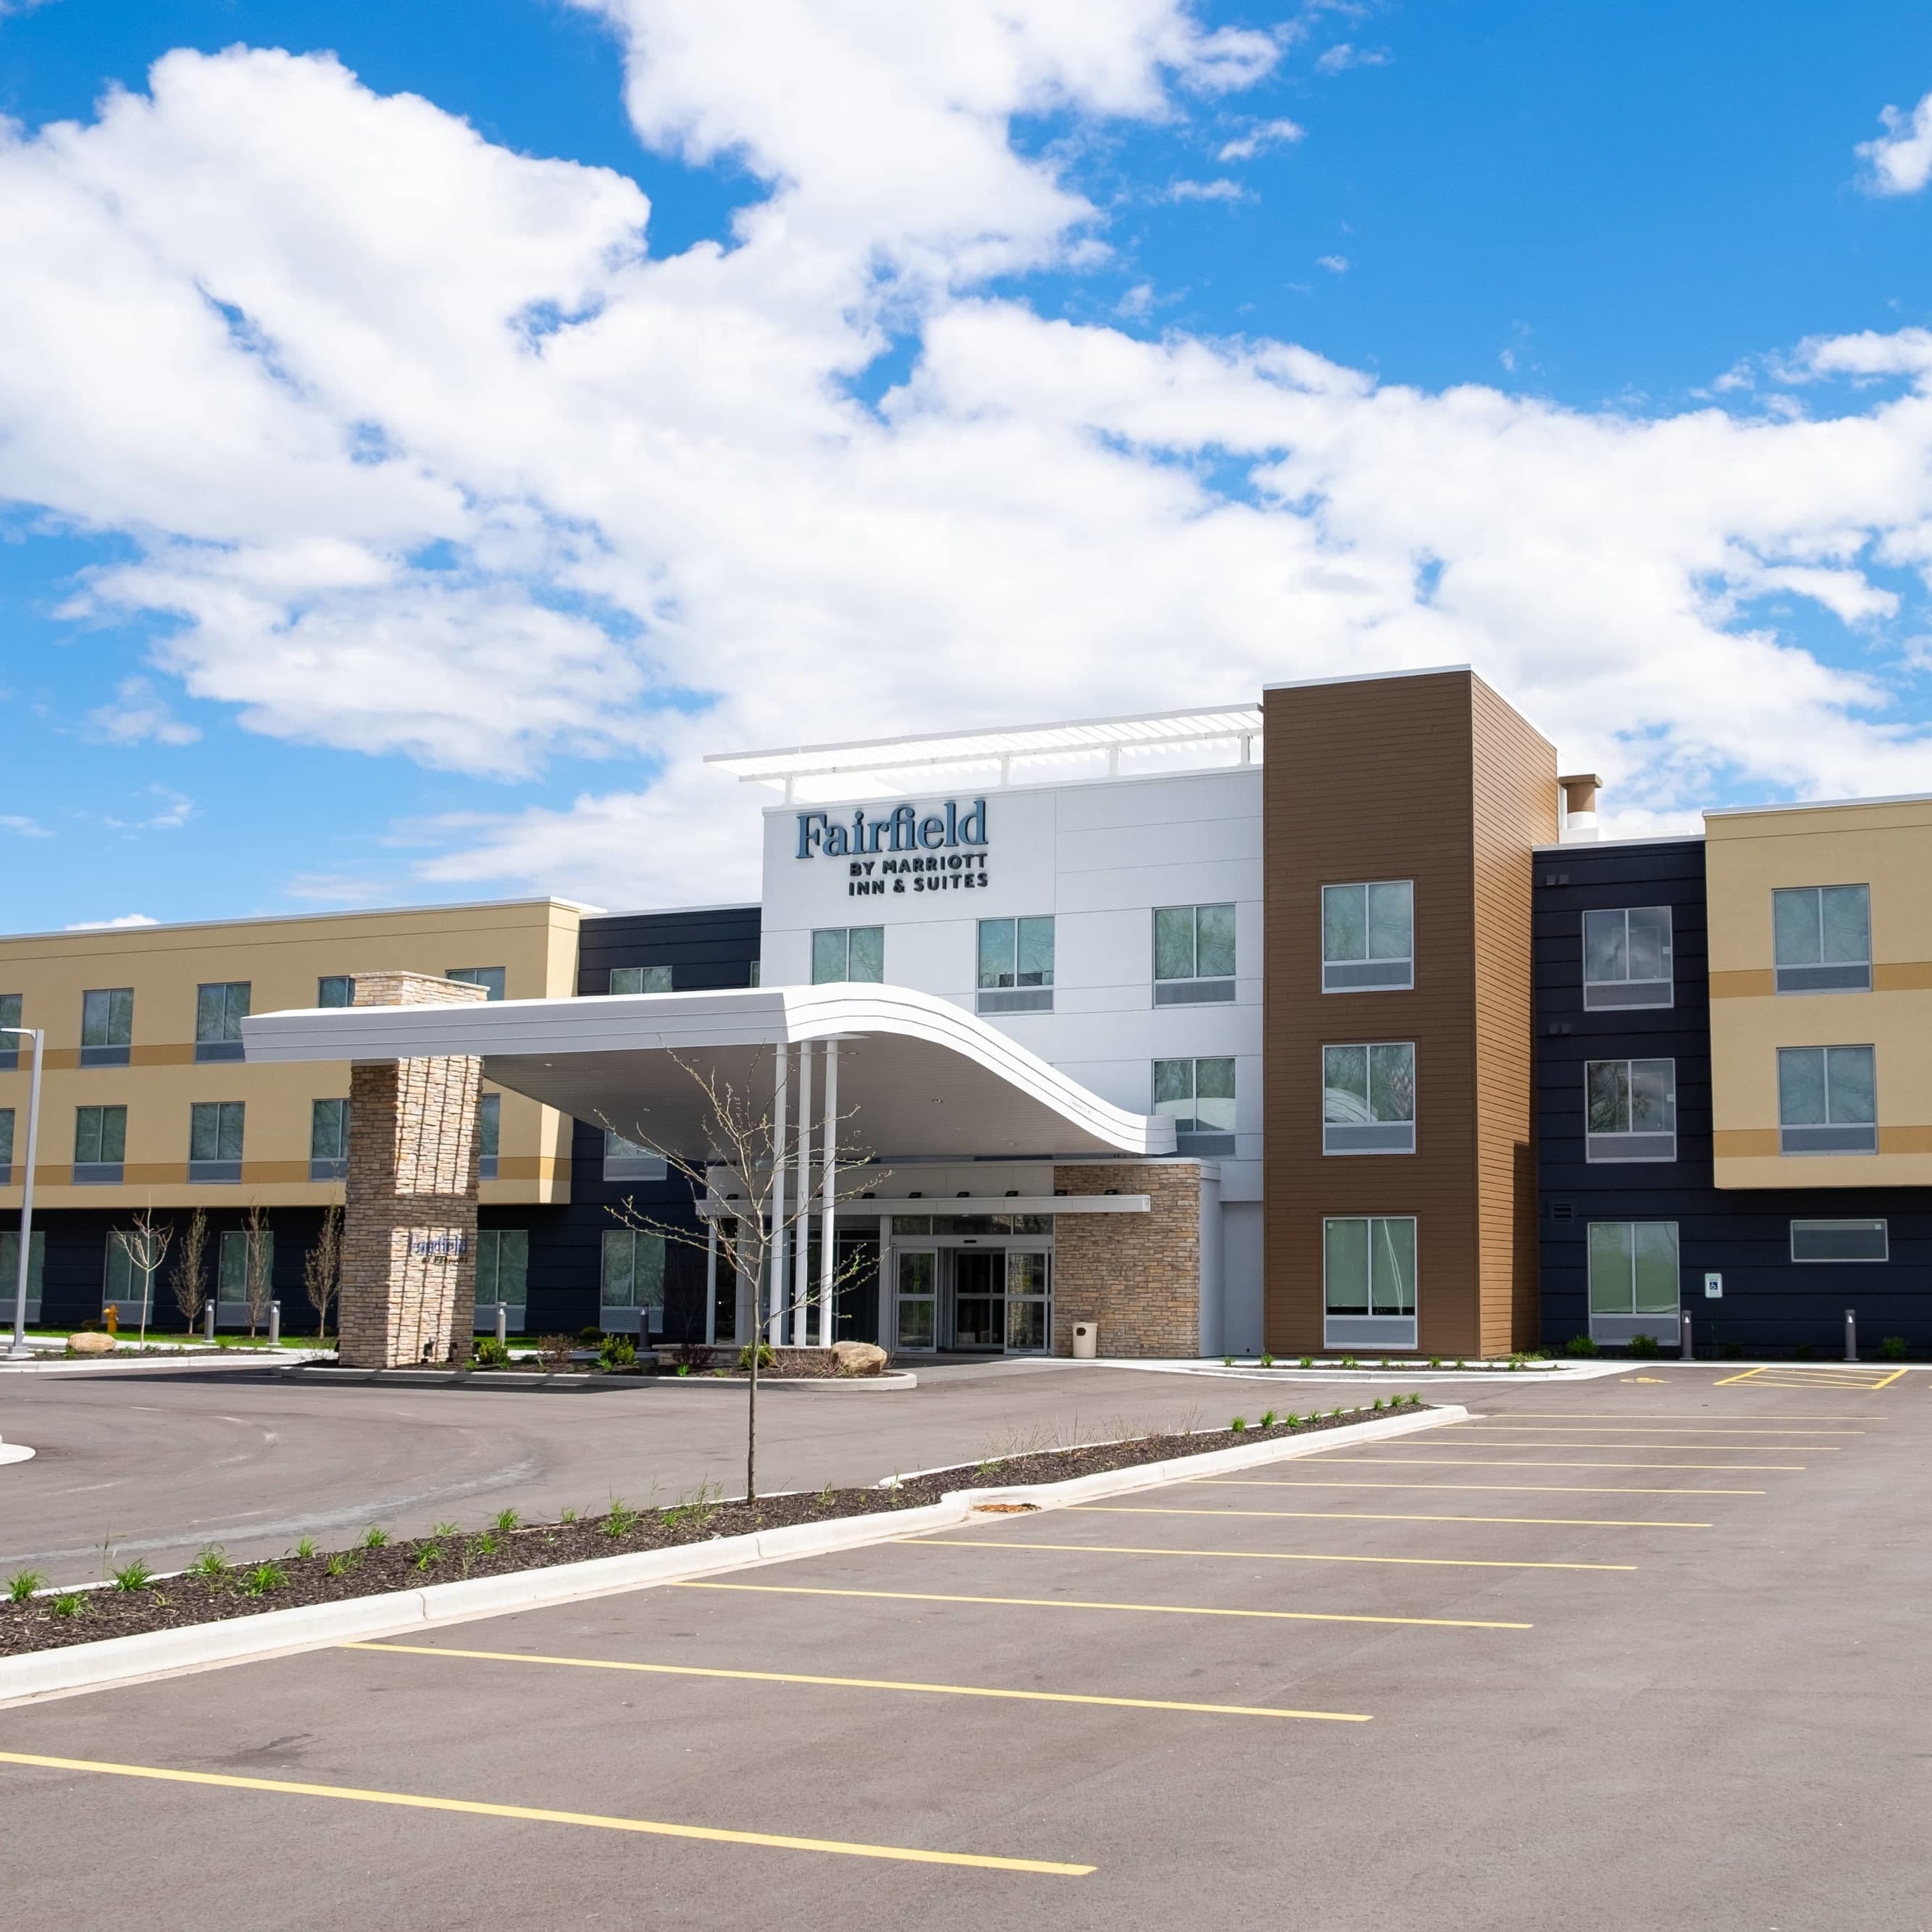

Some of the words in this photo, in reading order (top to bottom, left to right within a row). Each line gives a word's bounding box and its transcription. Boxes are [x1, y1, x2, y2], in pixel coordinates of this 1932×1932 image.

[795, 798, 989, 859] Fairfield
[850, 861, 875, 877] BY
[882, 853, 988, 874] MARRIOTT
[848, 880, 885, 896] INN
[892, 879, 906, 893] &
[913, 873, 988, 892] SUITES
